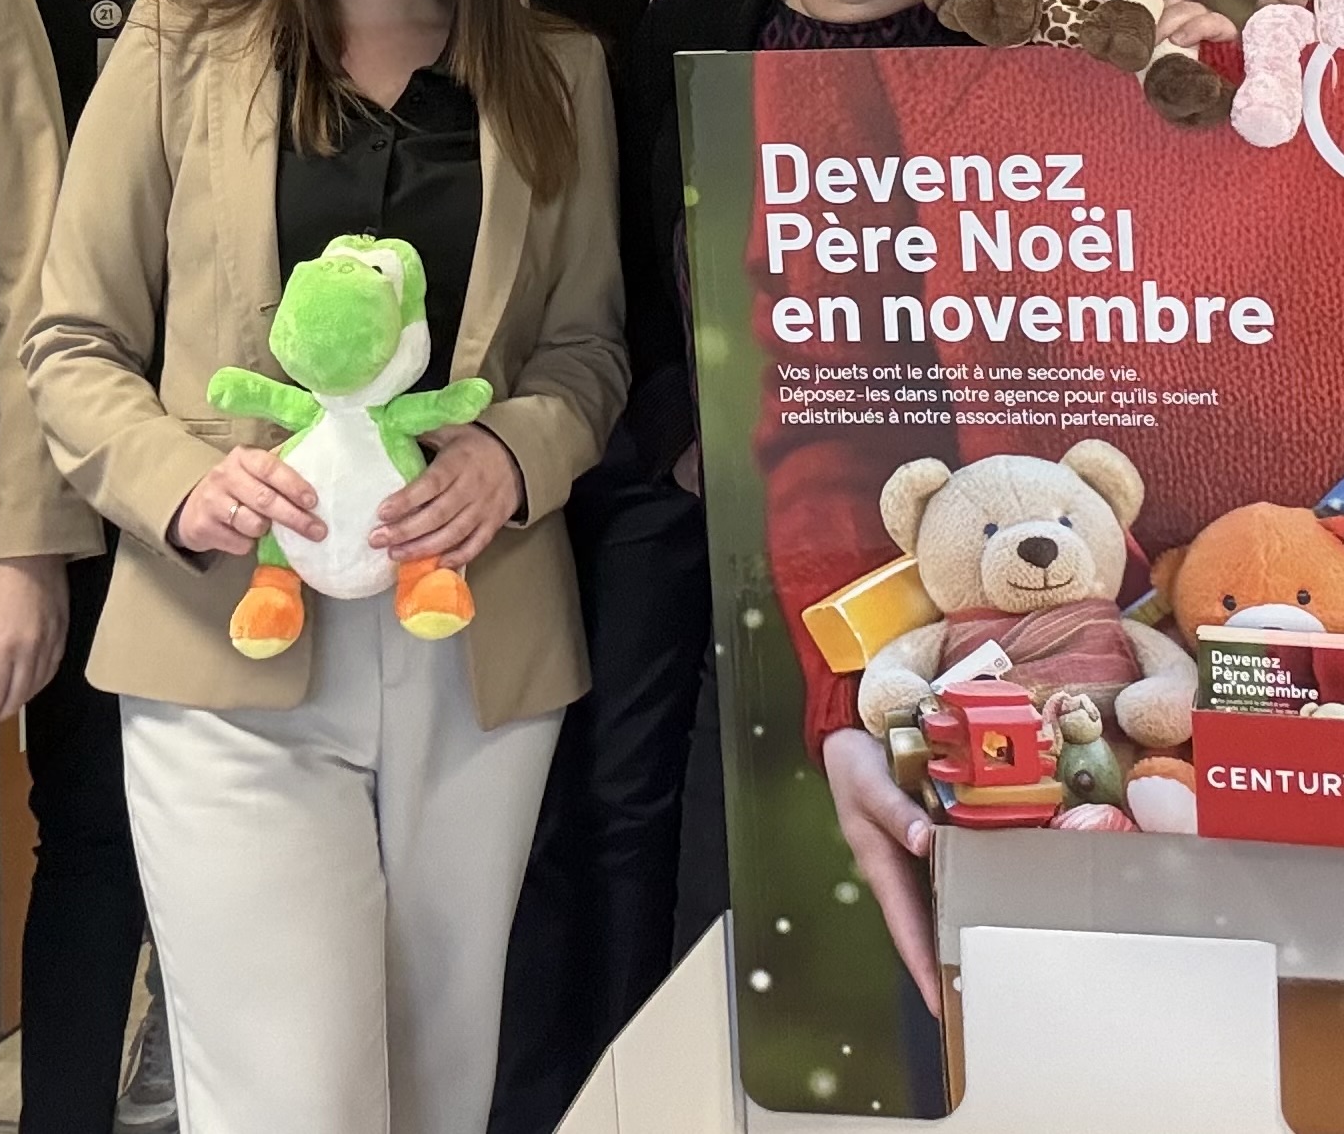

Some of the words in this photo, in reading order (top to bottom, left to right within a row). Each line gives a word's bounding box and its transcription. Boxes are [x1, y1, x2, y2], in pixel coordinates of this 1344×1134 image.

[761, 143, 1086, 205] Devenez
[765, 211, 938, 274] Père
[959, 206, 1134, 273] Noël
[771, 293, 861, 345] en
[882, 279, 1275, 345] novembre
[777, 364, 811, 381] Vos
[814, 364, 869, 385] jouets
[872, 366, 902, 381] ont
[906, 364, 923, 381] le
[926, 364, 969, 381] droit
[973, 364, 985, 381] à
[988, 366, 1023, 381] une
[1027, 364, 1106, 382] seconde
[1110, 364, 1141, 382] vie.
[779, 385, 891, 406] Déposez-les
[894, 385, 938, 403] dans
[942, 387, 990, 403] notre
[994, 389, 1060, 407] agence
[1064, 389, 1106, 408] pour
[1110, 387, 1158, 409] qu'ils
[1161, 388, 1219, 405] soient
[781, 407, 885, 425] redistribués
[888, 407, 900, 425] à
[904, 409, 952, 425] notre
[955, 408, 1057, 426] association
[1060, 410, 1159, 430] partenaire.
[1210, 649, 1281, 670] Devenez
[1211, 665, 1251, 683] Père
[1253, 669, 1292, 685] Noël
[1212, 682, 1234, 695] en
[1236, 682, 1320, 701] novembre
